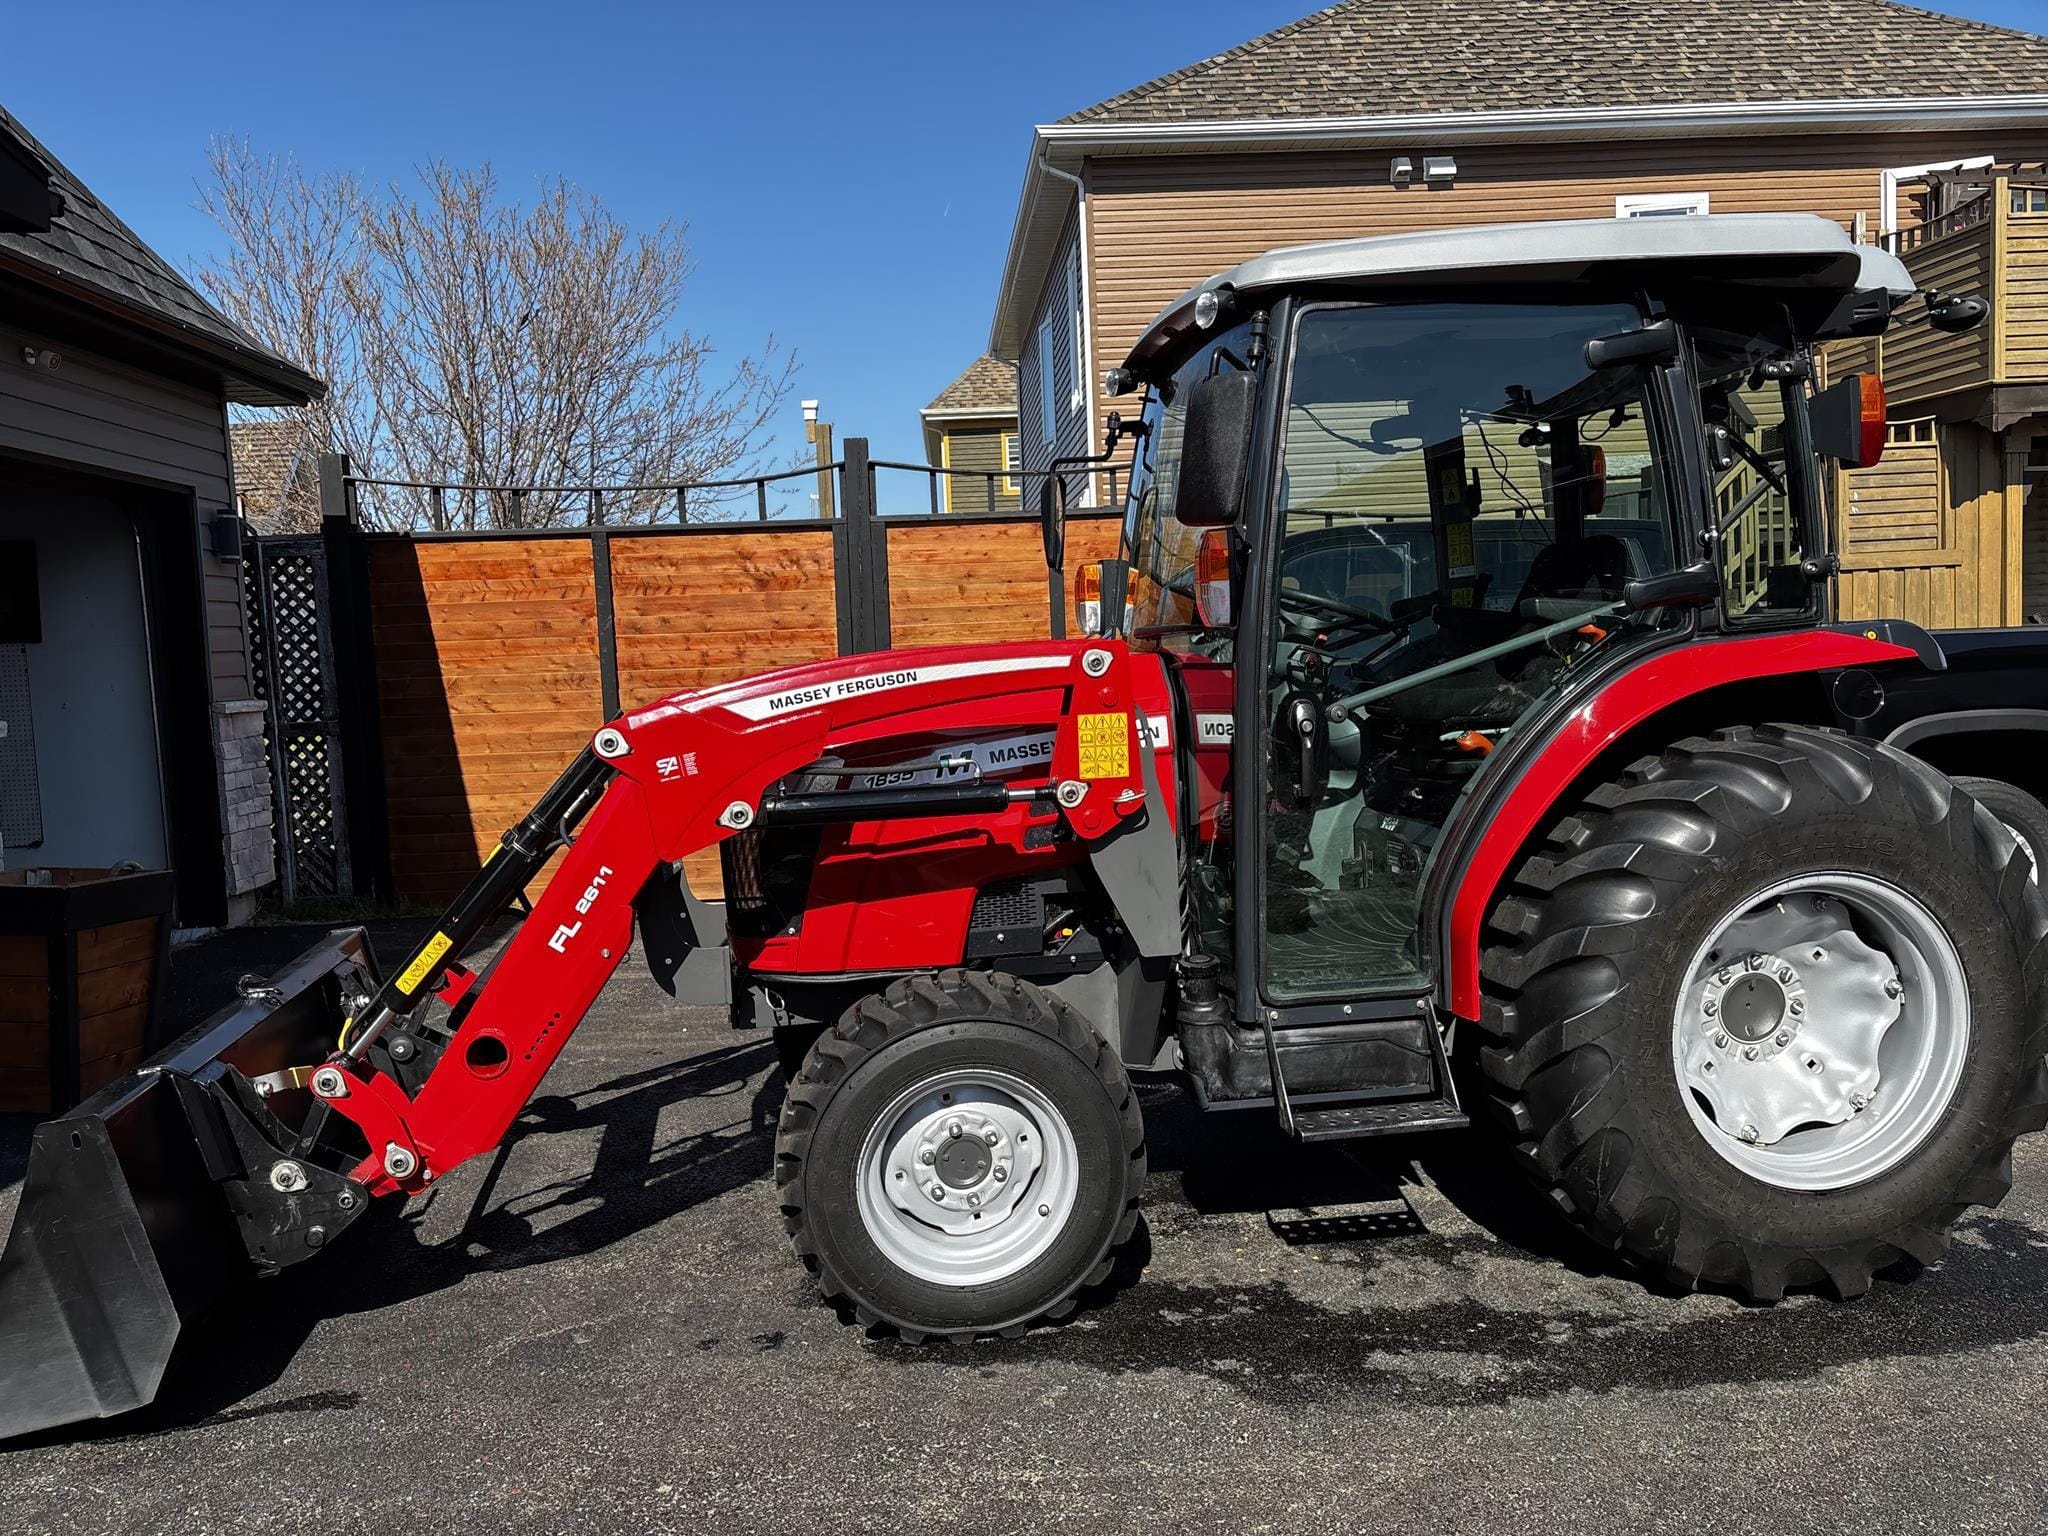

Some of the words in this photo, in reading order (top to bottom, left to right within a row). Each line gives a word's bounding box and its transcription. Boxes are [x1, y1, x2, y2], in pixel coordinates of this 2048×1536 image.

[769, 687, 831, 710] MASSEY
[837, 671, 918, 695] FERGUSON
[935, 750, 973, 779] M
[548, 921, 583, 953] FL
[575, 866, 613, 915] 2611
